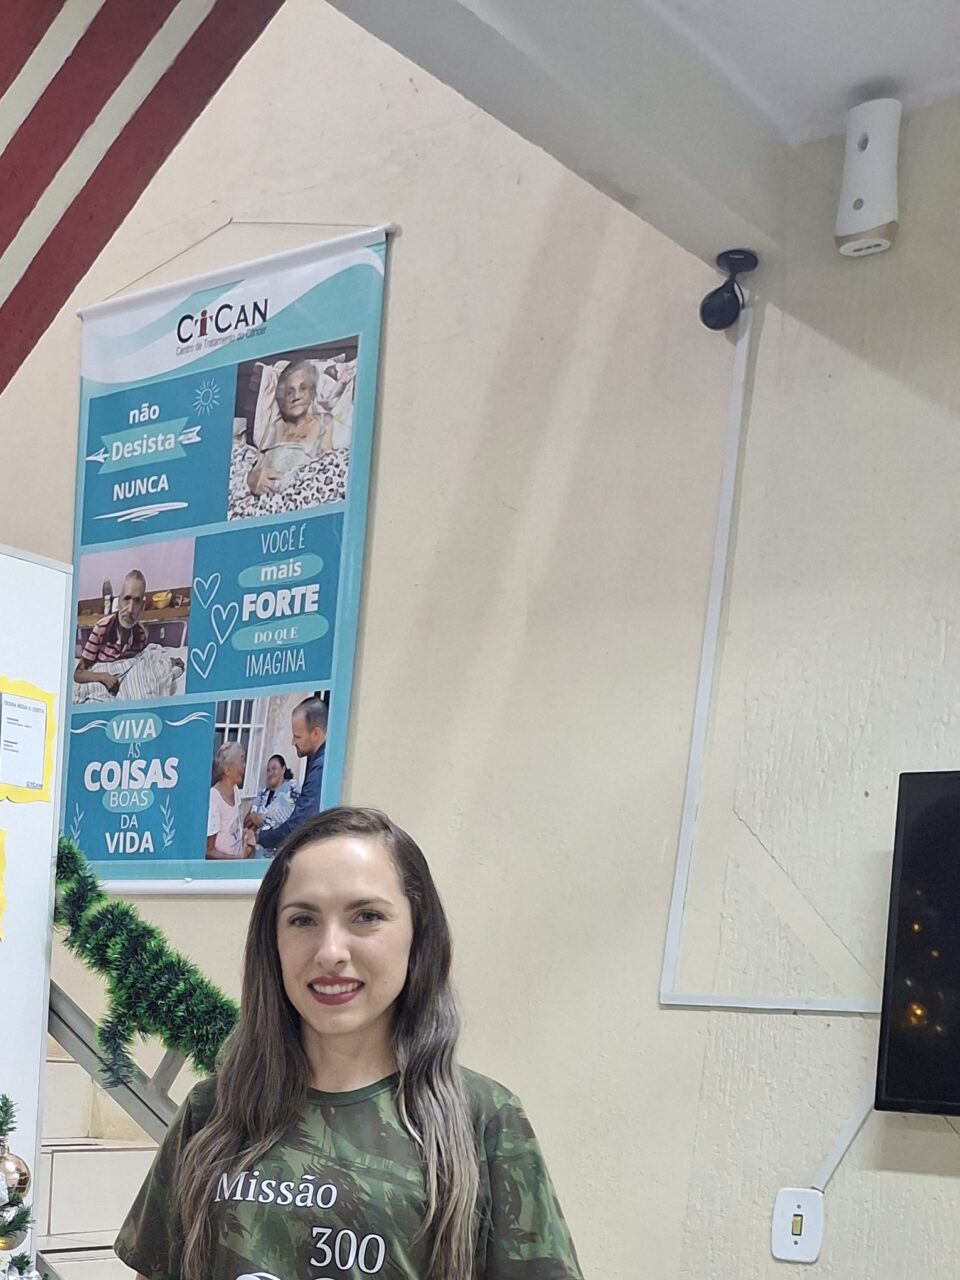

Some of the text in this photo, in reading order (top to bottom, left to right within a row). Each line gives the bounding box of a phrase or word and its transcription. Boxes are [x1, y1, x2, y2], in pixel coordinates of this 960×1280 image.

[129, 403, 160, 424] não
[111, 433, 176, 461] Desista
[113, 474, 169, 501] NUNCA
[261, 522, 307, 554] VOCÊ É
[260, 559, 302, 582] mais
[242, 584, 320, 622] FORTE
[254, 626, 299, 645] DO QUE
[246, 648, 306, 678] IMAGINA
[112, 718, 157, 740] VIVA
[128, 742, 141, 758] AS
[84, 757, 180, 792] COISAS
[110, 790, 149, 807] BOAS
[120, 814, 138, 829] DA
[105, 831, 154, 854] VIDA
[214, 1170, 338, 1208] Missão
[309, 1226, 386, 1274] 300
